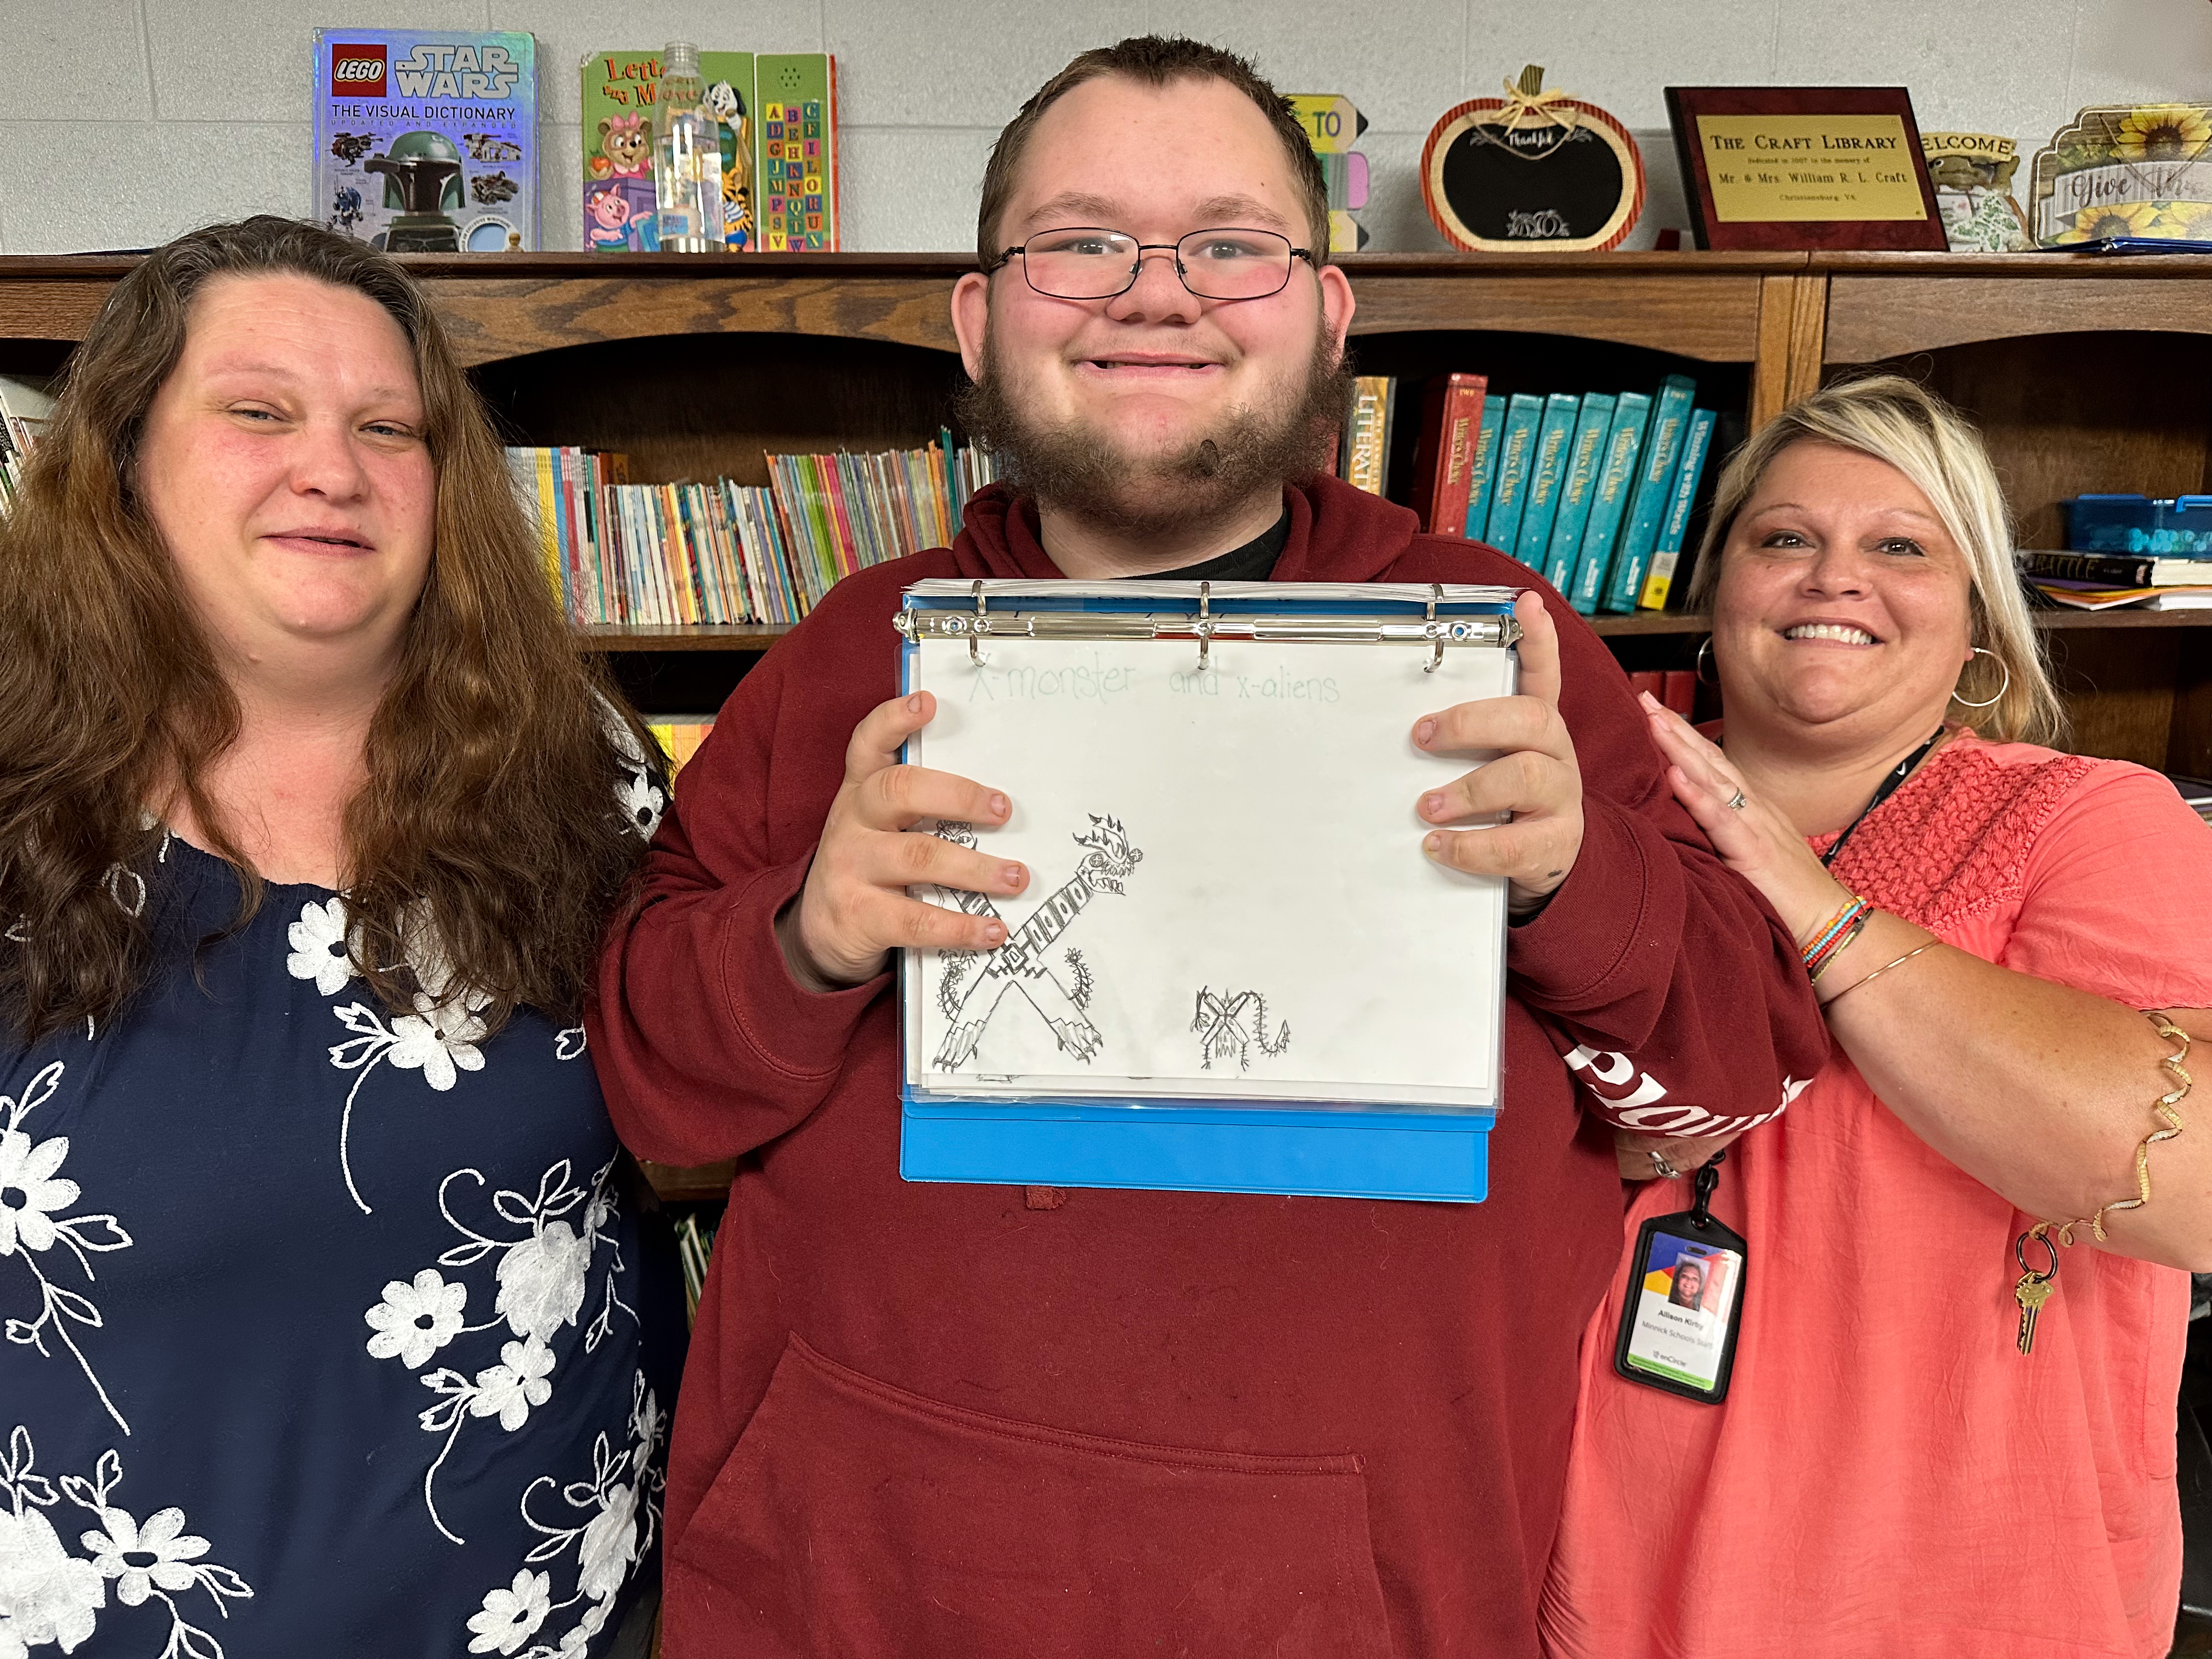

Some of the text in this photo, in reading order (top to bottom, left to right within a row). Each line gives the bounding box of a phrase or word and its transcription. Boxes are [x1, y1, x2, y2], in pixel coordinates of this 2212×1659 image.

[394, 45, 518, 72] STAR
[335, 60, 384, 81] LEGO
[395, 71, 518, 99] WARS
[332, 105, 515, 120] THE VISUAL DICTIONARY
[769, 105, 816, 122] A B C
[770, 123, 816, 141] D E F
[1312, 111, 1341, 138] TO
[770, 143, 815, 159] G H I
[1709, 134, 1897, 150] THE CRAFT LIBRARY
[1921, 136, 2010, 155] ELCOME
[772, 160, 817, 177] J K L
[1788, 172, 1835, 184] William
[1875, 171, 1908, 184] Craft
[771, 179, 818, 196] M N O
[2071, 173, 2131, 208] Give
[772, 198, 818, 217] P Q R
[791, 221, 800, 233] T
[808, 217, 819, 229] U
[772, 235, 783, 248] V
[789, 239, 803, 252] W
[965, 651, 1340, 704] X-monster and x-aliens
[1658, 1310, 1704, 1331] Allison Kirby
[1641, 1321, 1668, 1335] Minnick
[1669, 1329, 1695, 1344] Schools
